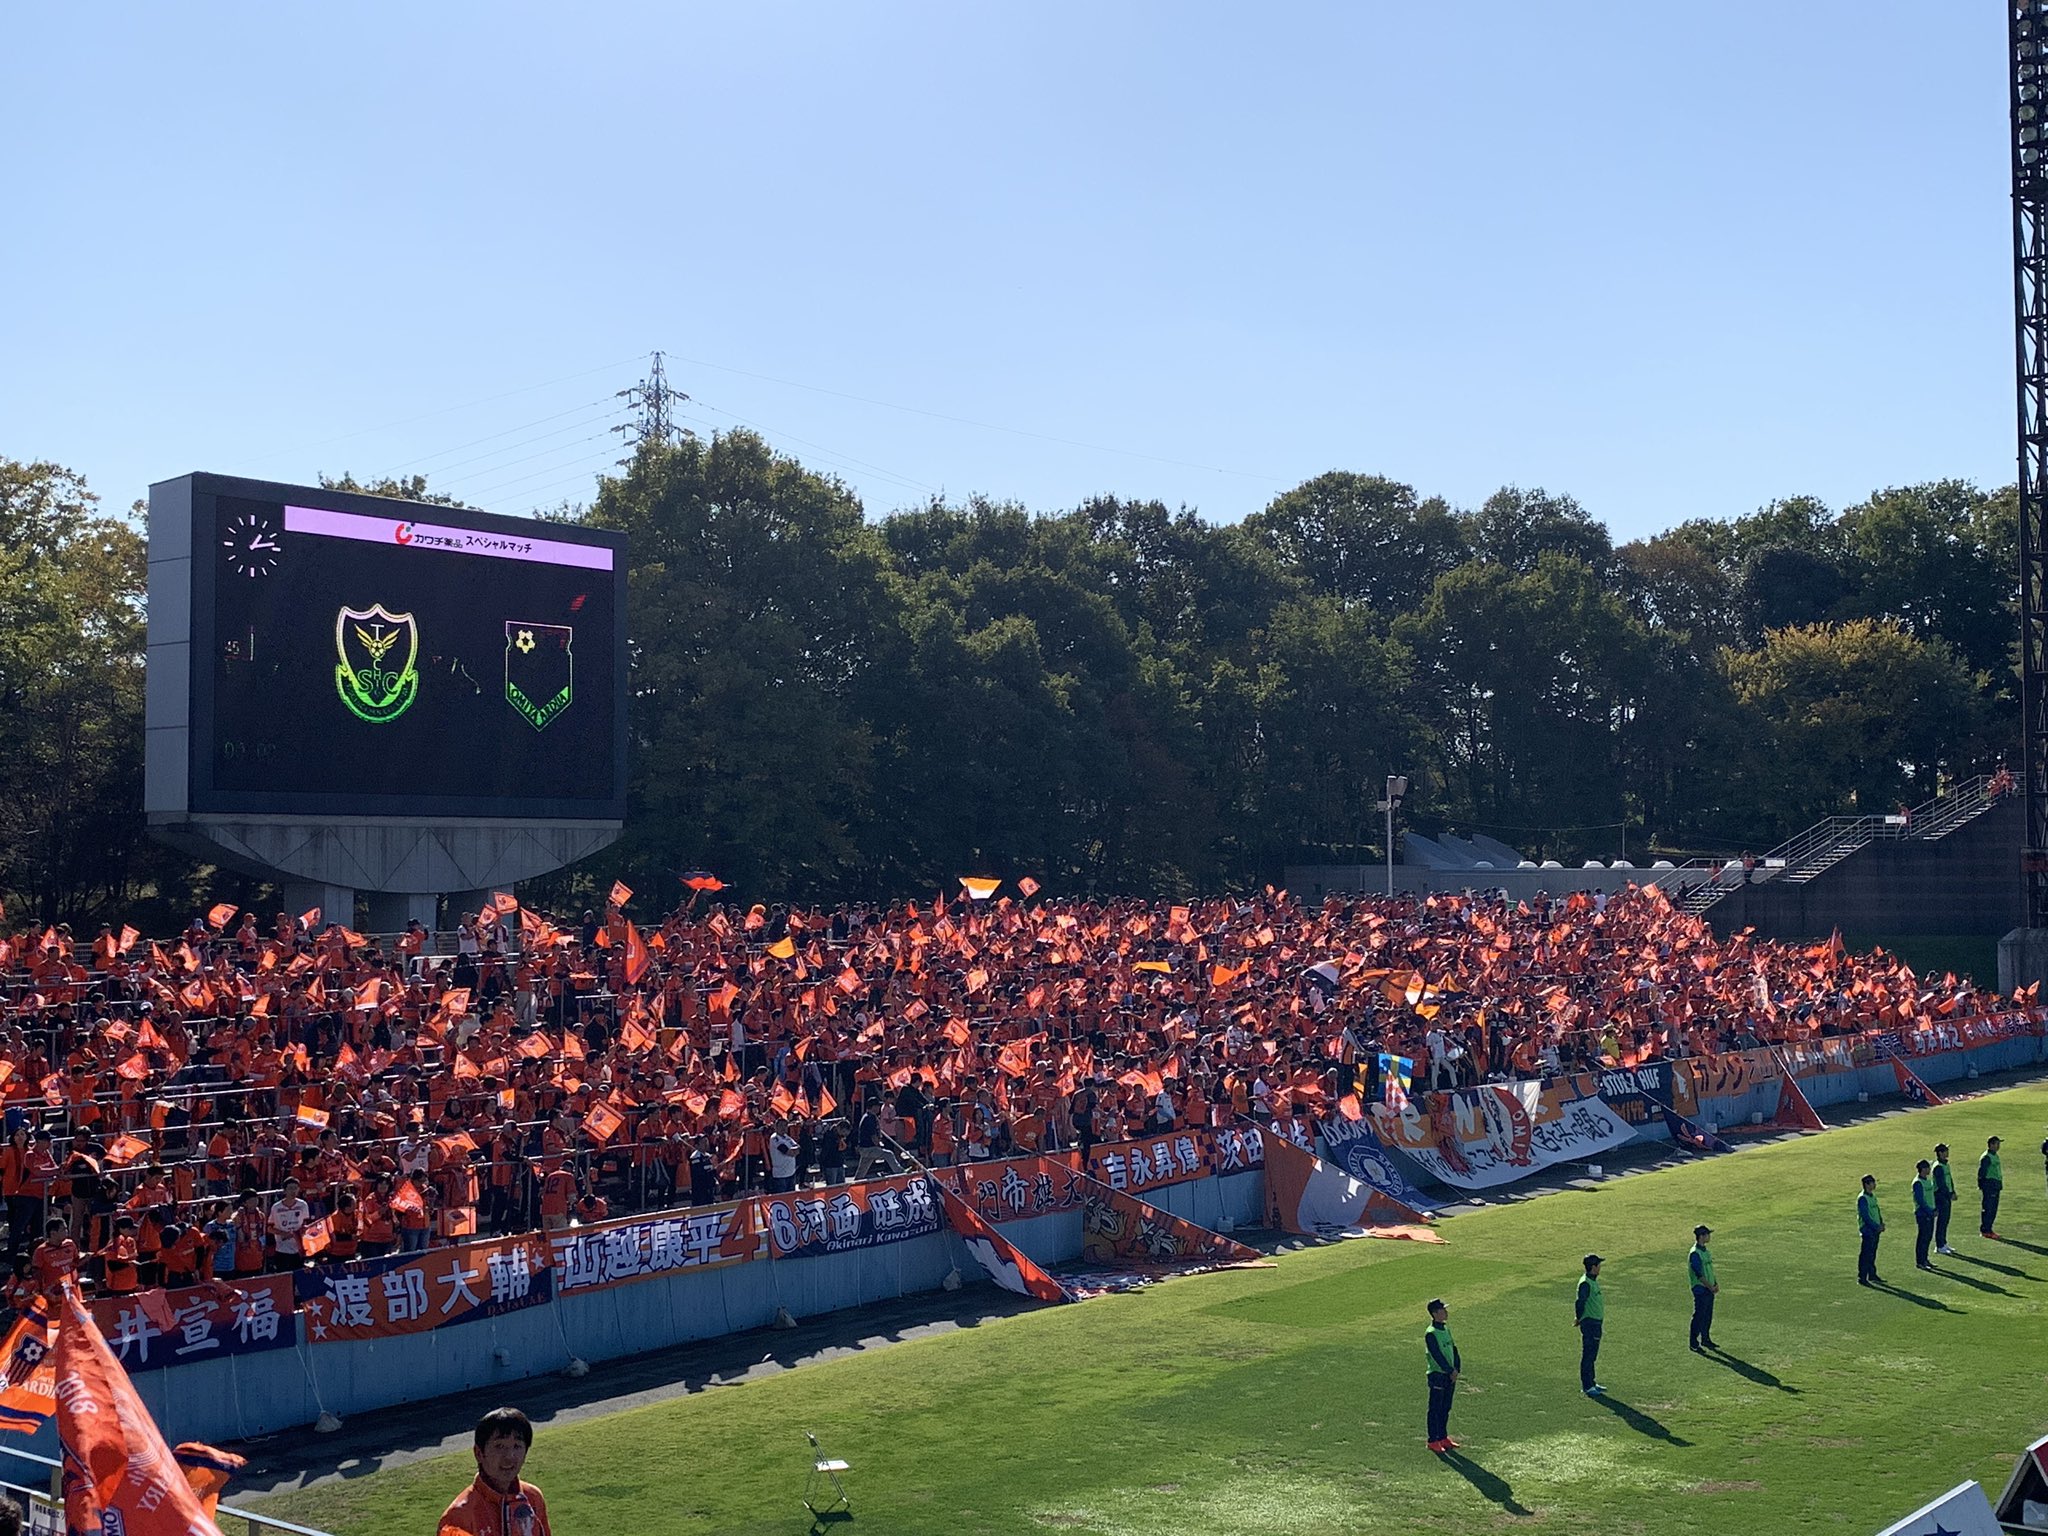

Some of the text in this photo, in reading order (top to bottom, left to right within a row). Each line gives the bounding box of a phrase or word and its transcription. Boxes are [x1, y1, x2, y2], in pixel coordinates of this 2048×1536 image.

[414, 534, 532, 554] カワチ薬品 スペシャルマッチ
[1602, 1068, 1660, 1097] STOLZ AUF
[323, 1247, 532, 1328] 渡部大輔
